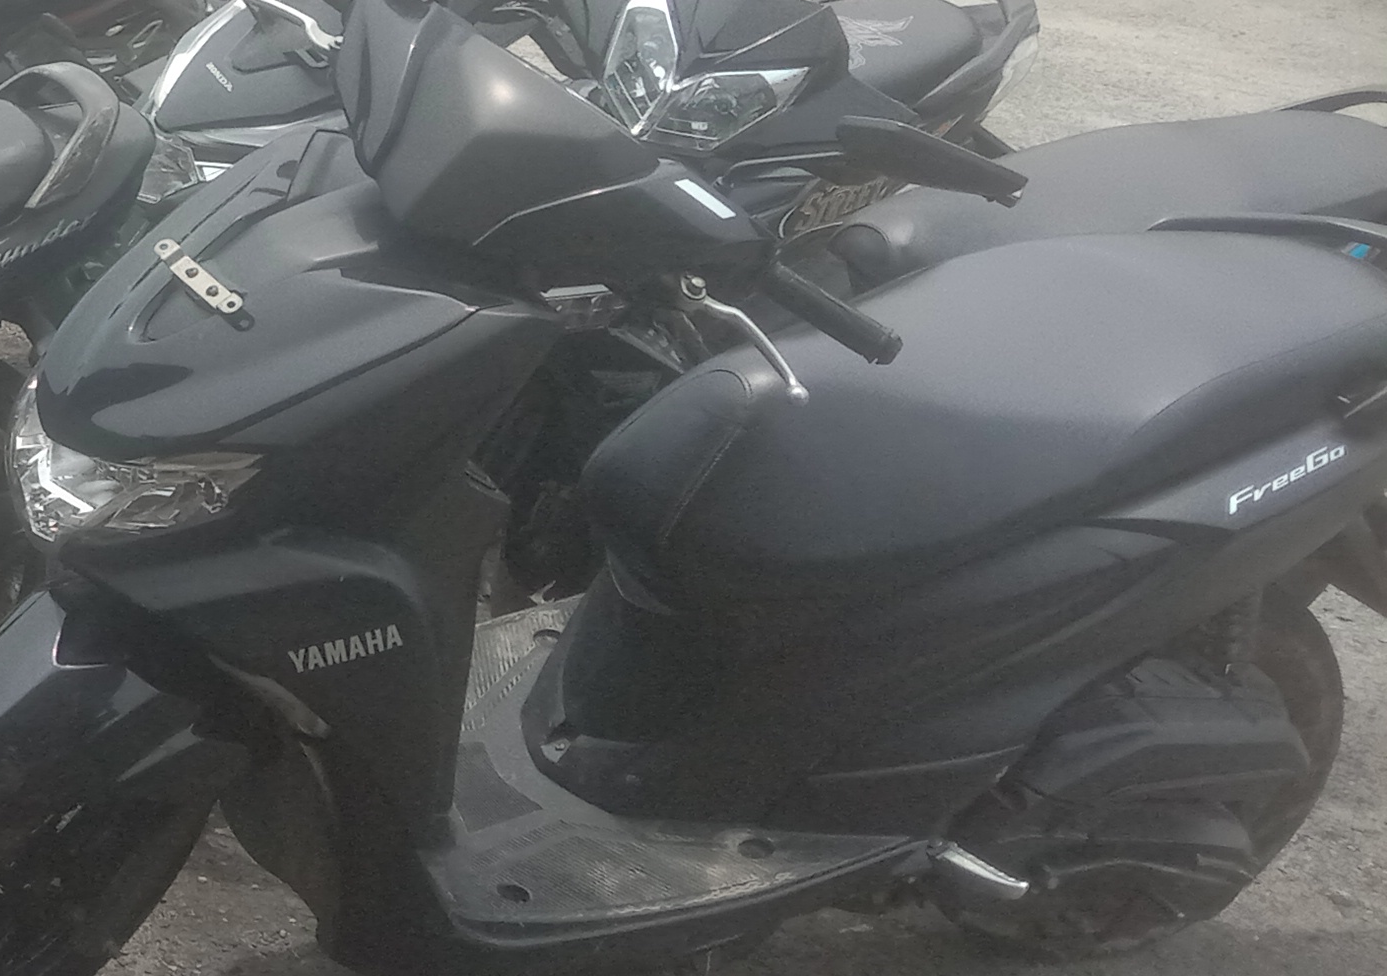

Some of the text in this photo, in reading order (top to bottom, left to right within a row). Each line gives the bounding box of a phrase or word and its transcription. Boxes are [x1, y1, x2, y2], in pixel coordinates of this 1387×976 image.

[205, 61, 234, 93] HONDA
[1228, 444, 1347, 515] FreeGo
[287, 624, 404, 674] YAMAHA
